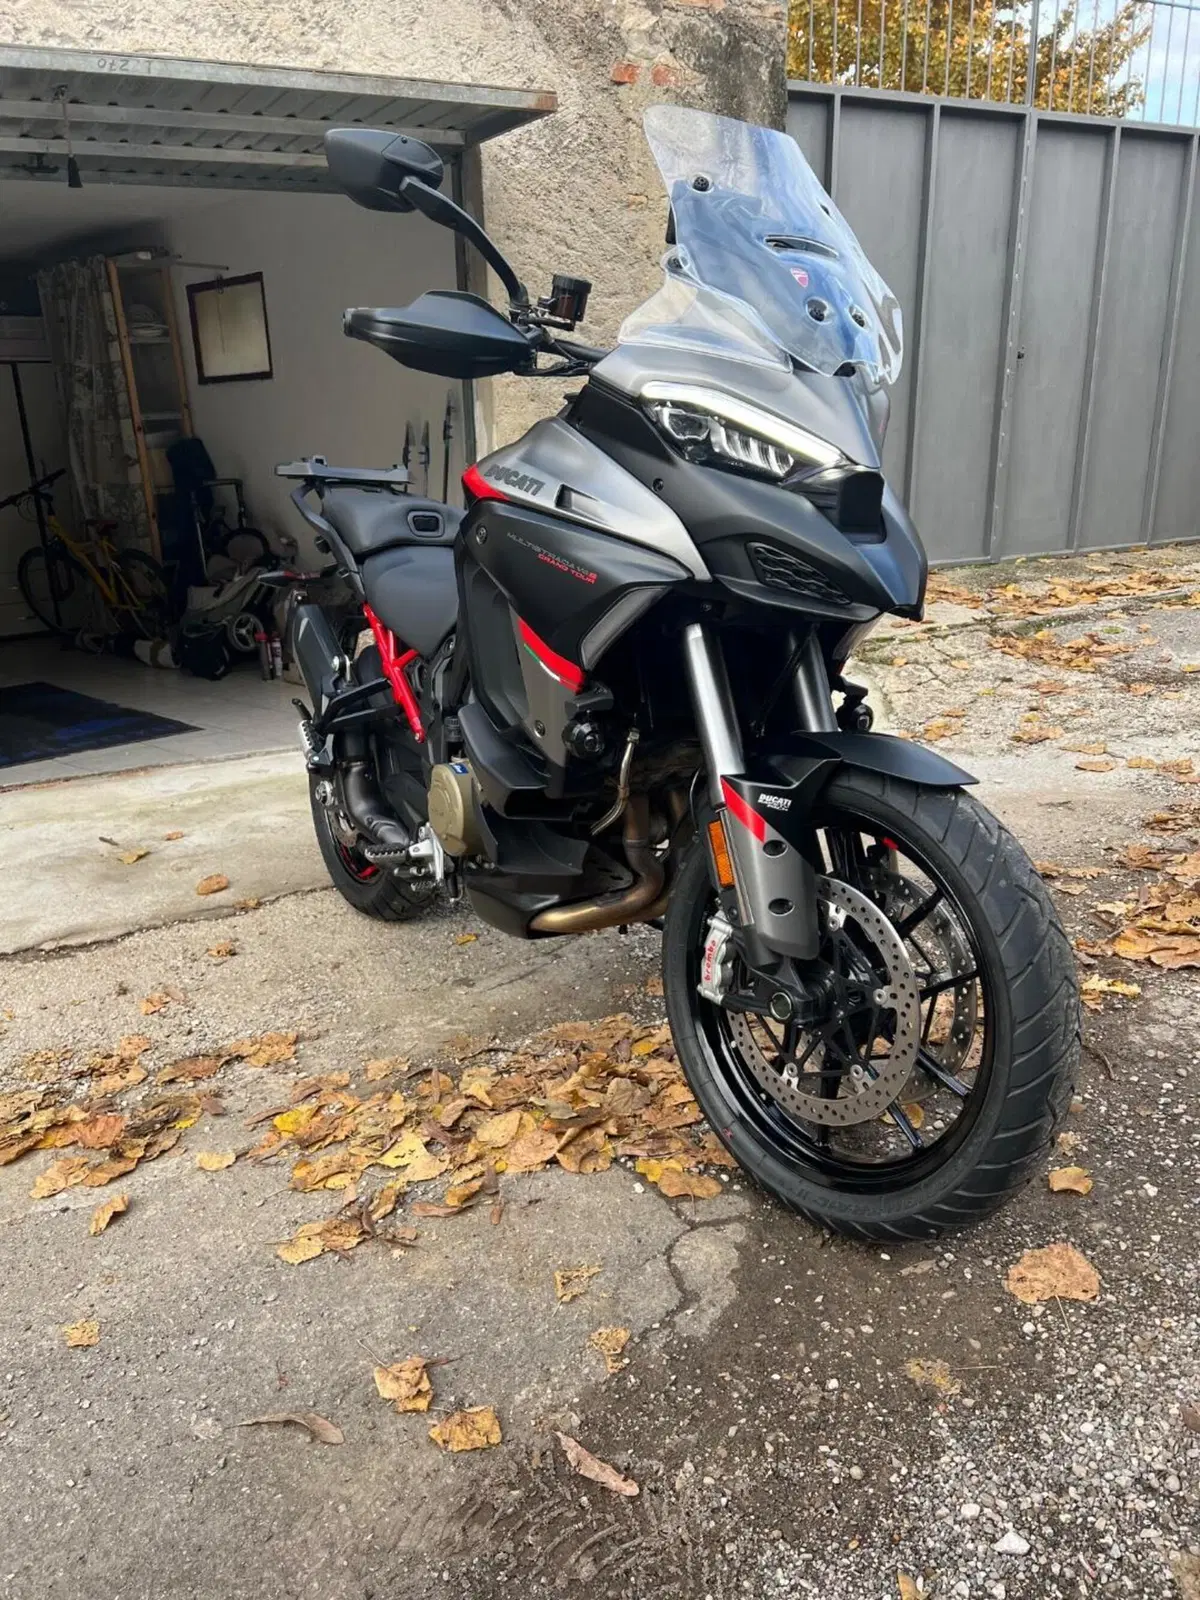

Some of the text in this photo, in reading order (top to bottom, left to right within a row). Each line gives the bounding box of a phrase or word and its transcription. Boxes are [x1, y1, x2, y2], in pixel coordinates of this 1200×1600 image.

[484, 464, 546, 496] DUCATI
[537, 553, 595, 584] GRAND TOUR
[757, 793, 792, 808] DUCATI
[703, 940, 716, 981] brembo
